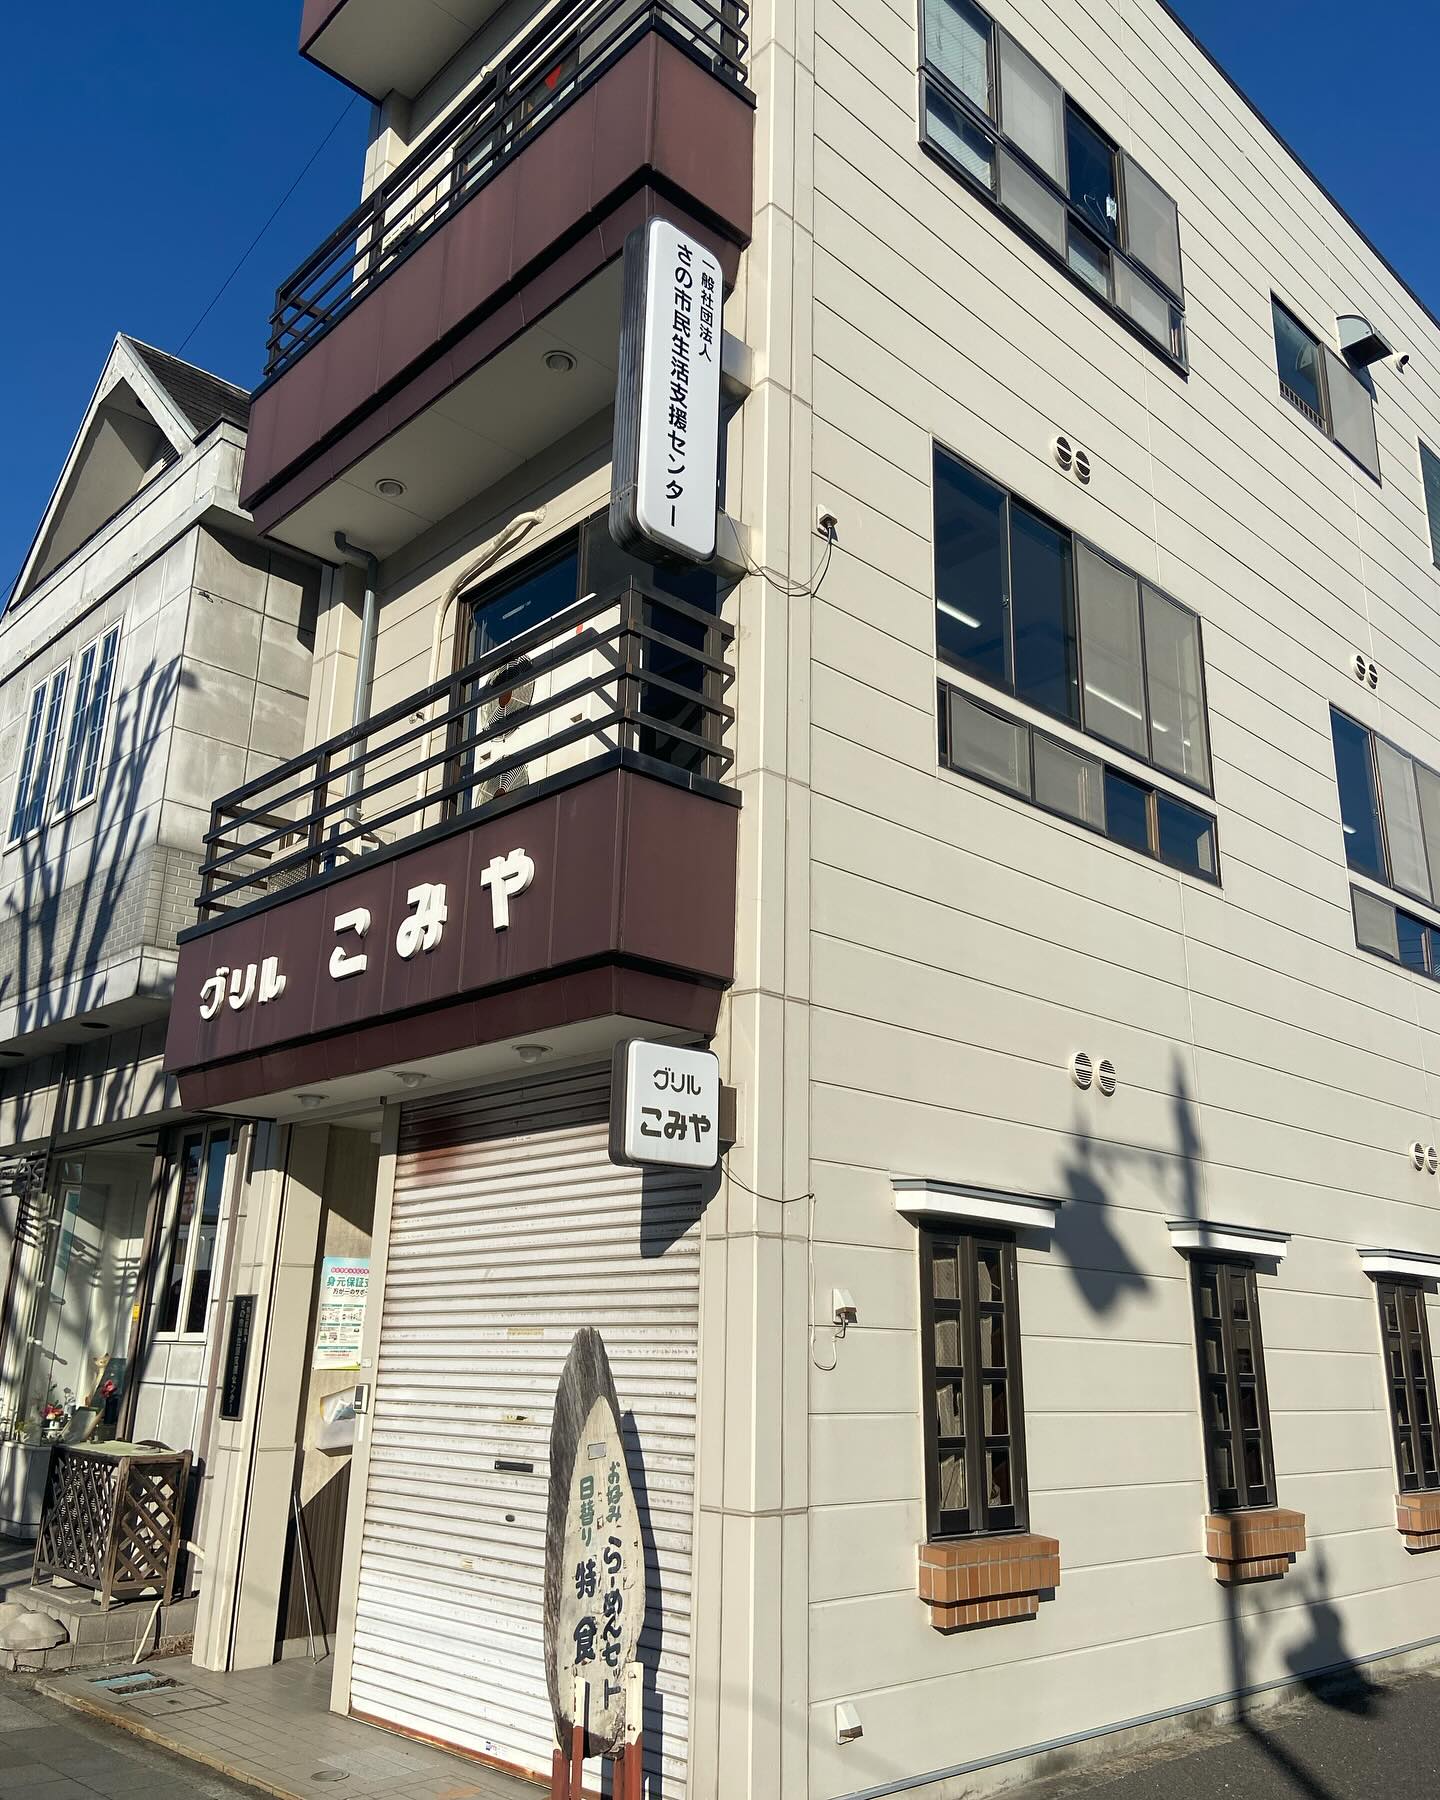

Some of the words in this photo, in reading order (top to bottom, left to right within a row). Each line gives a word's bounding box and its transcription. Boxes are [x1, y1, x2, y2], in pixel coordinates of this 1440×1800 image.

[699, 258, 716, 363] 一般社団法人
[664, 243, 693, 528] さの市民生活支援センター
[199, 955, 287, 1021] グリル
[328, 846, 536, 980] こみや
[640, 1106, 712, 1143] こみや
[653, 1067, 702, 1096] グリル
[573, 1558, 598, 1665] 特食
